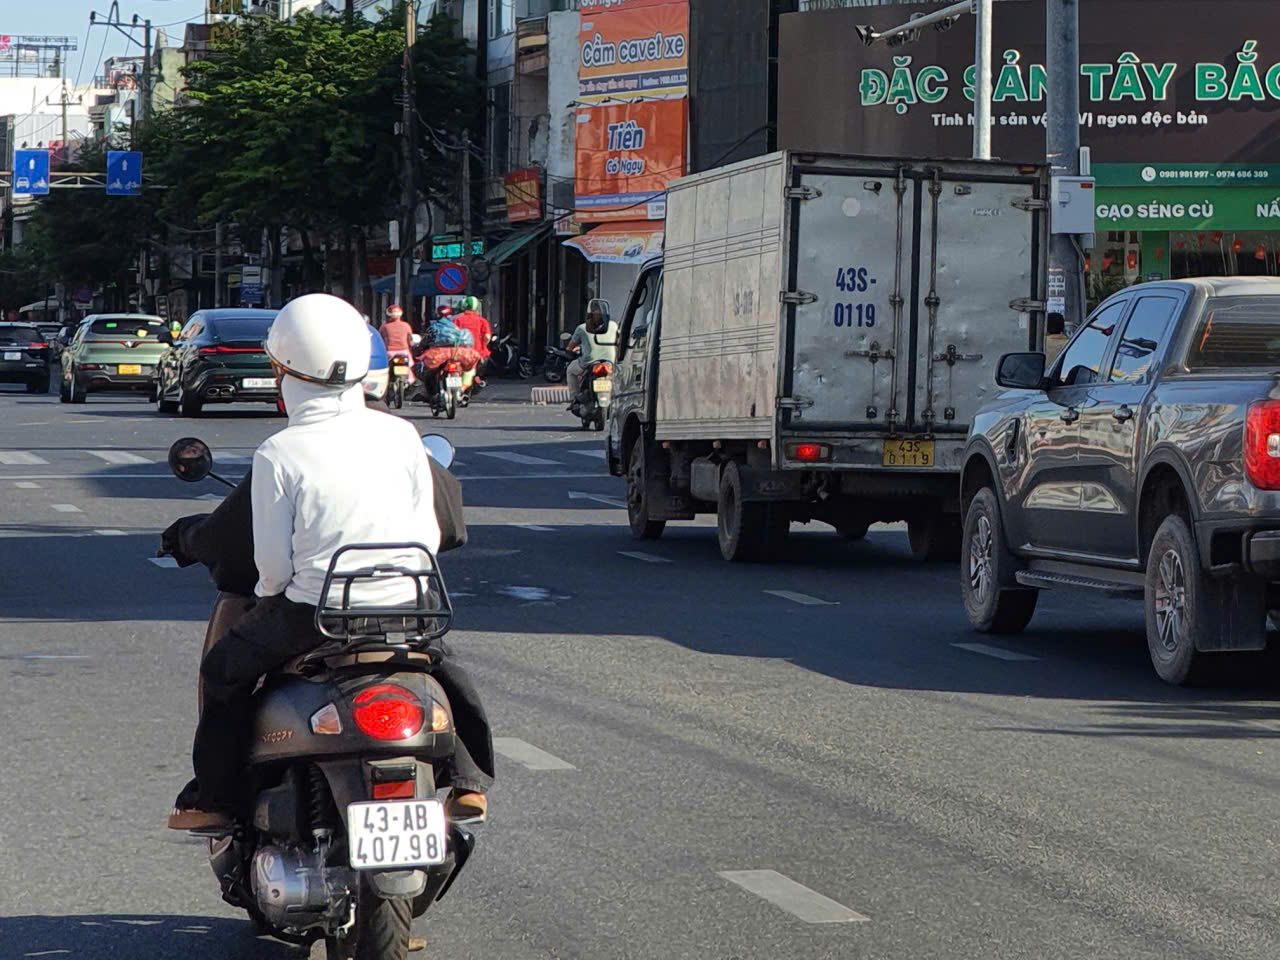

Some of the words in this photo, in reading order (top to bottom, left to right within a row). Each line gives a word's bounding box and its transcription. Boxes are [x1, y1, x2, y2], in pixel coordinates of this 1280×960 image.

[582, 31, 616, 68] Cầm
[619, 30, 662, 64] cavet
[663, 33, 685, 59] xe
[859, 55, 948, 114] ĐẶC
[962, 49, 1049, 102] SẢN
[1080, 51, 1177, 102] TÂY
[931, 113, 965, 126] Tinh
[1000, 111, 1027, 126] sản
[1031, 112, 1048, 128] vậ
[1097, 115, 1137, 127] ngon
[1141, 111, 1172, 127] độc
[1177, 110, 1208, 125] bản
[607, 120, 645, 151] Tiền
[606, 158, 619, 174] Có
[620, 159, 645, 175] Ngay
[1096, 204, 1134, 222] GẠO
[1137, 200, 1184, 218] SÉNG
[1188, 199, 1214, 218] CÙ
[833, 302, 876, 328] 0119
[889, 452, 929, 465] 0119
[899, 441, 920, 452] 43S
[363, 804, 428, 833] 43-AB
[356, 833, 438, 864] 407.98
